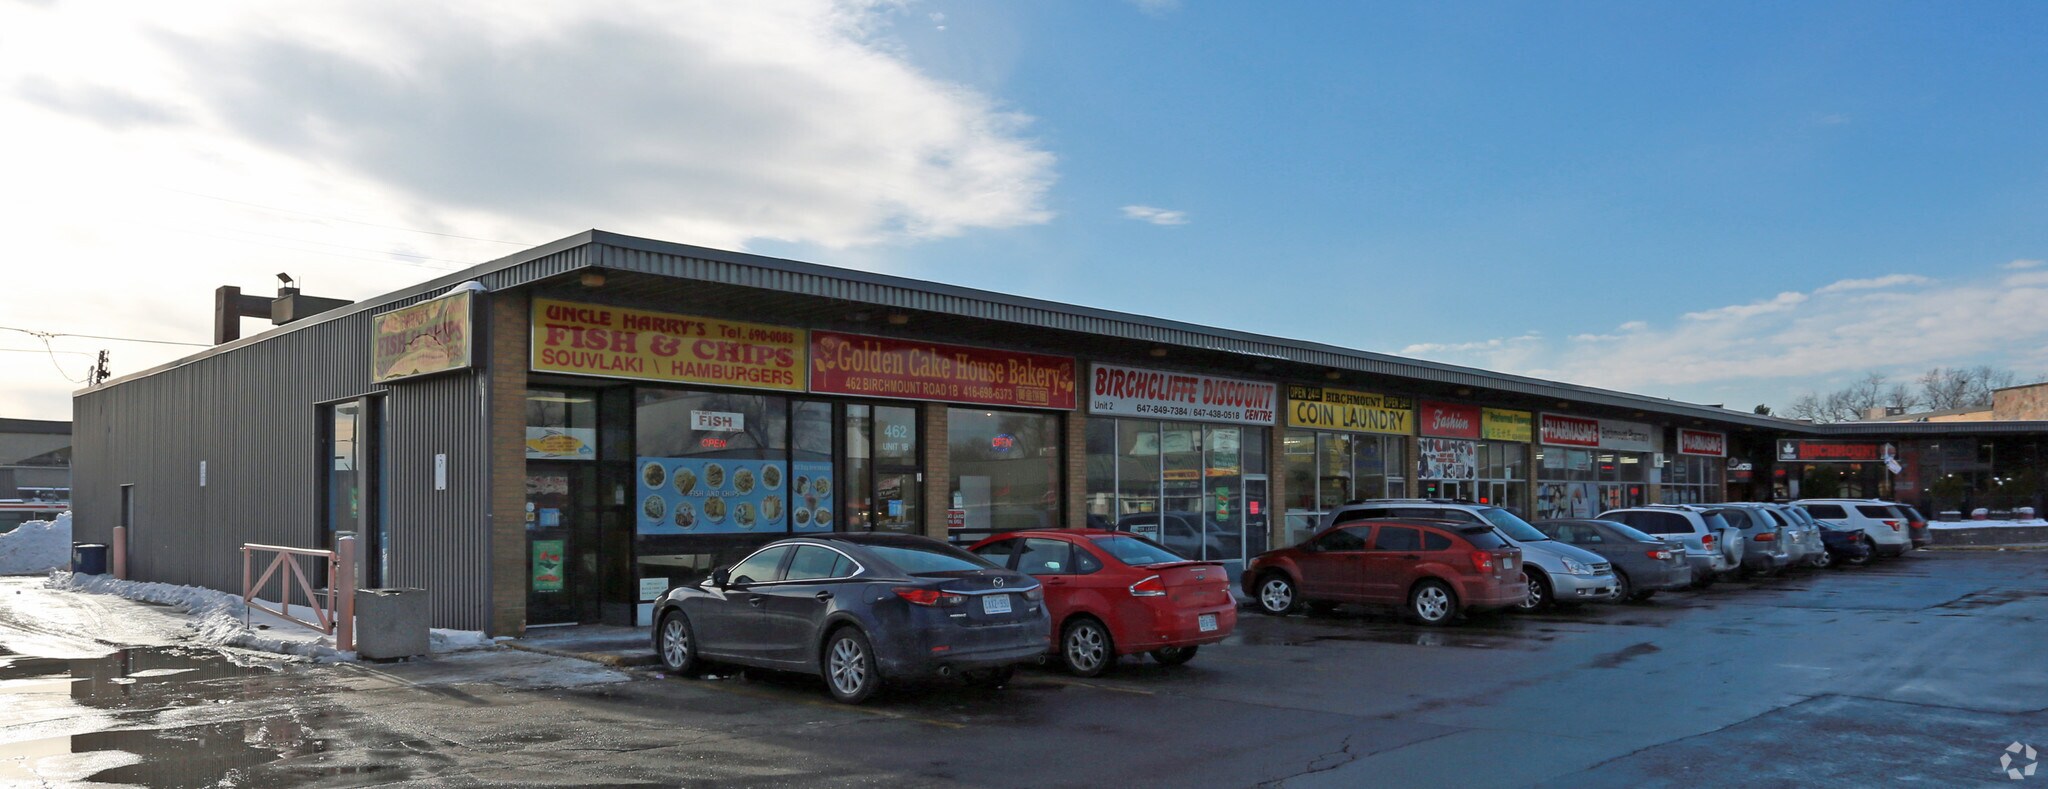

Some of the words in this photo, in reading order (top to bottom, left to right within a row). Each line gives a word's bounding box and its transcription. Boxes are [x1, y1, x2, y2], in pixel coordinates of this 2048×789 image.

[546, 305, 611, 326] UNCLE
[623, 314, 706, 336] HARRY'S
[720, 325, 745, 339] Tel.
[749, 327, 794, 343] 690-0085
[545, 324, 636, 356] FISH
[650, 334, 681, 357] &
[692, 339, 794, 368] CHIPS
[542, 347, 644, 373] SOUVLAKI
[671, 360, 794, 385] HAMBURGERS
[838, 342, 904, 376] Golden
[909, 349, 951, 379] Cake
[955, 353, 1004, 384] House
[1008, 358, 1060, 395] Bakery
[845, 376, 861, 390] 462
[863, 377, 921, 395] BIRCHMOUNT
[923, 382, 947, 396] ROAD
[948, 384, 959, 397] 1B
[963, 385, 1013, 401] 416-698-6373
[1095, 367, 1199, 404] BIRCHCLIFFE
[1203, 378, 1274, 410] DISCOUNT
[1289, 386, 1306, 399] OPEN
[1094, 401, 1108, 410] Unit
[1109, 402, 1114, 411] 2
[1325, 392, 1381, 408] BIRCHMOUNT
[1136, 403, 1188, 416] 647-849-7384
[1193, 408, 1240, 420] 647-438-0518
[1244, 408, 1273, 422] CENTRE
[1297, 402, 1334, 426] COIN
[1343, 406, 1405, 431] LAUNDRY
[1433, 408, 1469, 430] Fashion
[699, 415, 732, 428] FISH
[884, 424, 907, 438] 462
[1544, 419, 1597, 443] PHARMASAVE
[702, 438, 728, 448] OPEN
[882, 442, 898, 451] UNIT
[992, 437, 1013, 448] OPEN
[1683, 432, 1722, 452] PHARMASAVE
[690, 489, 704, 497] FISH
